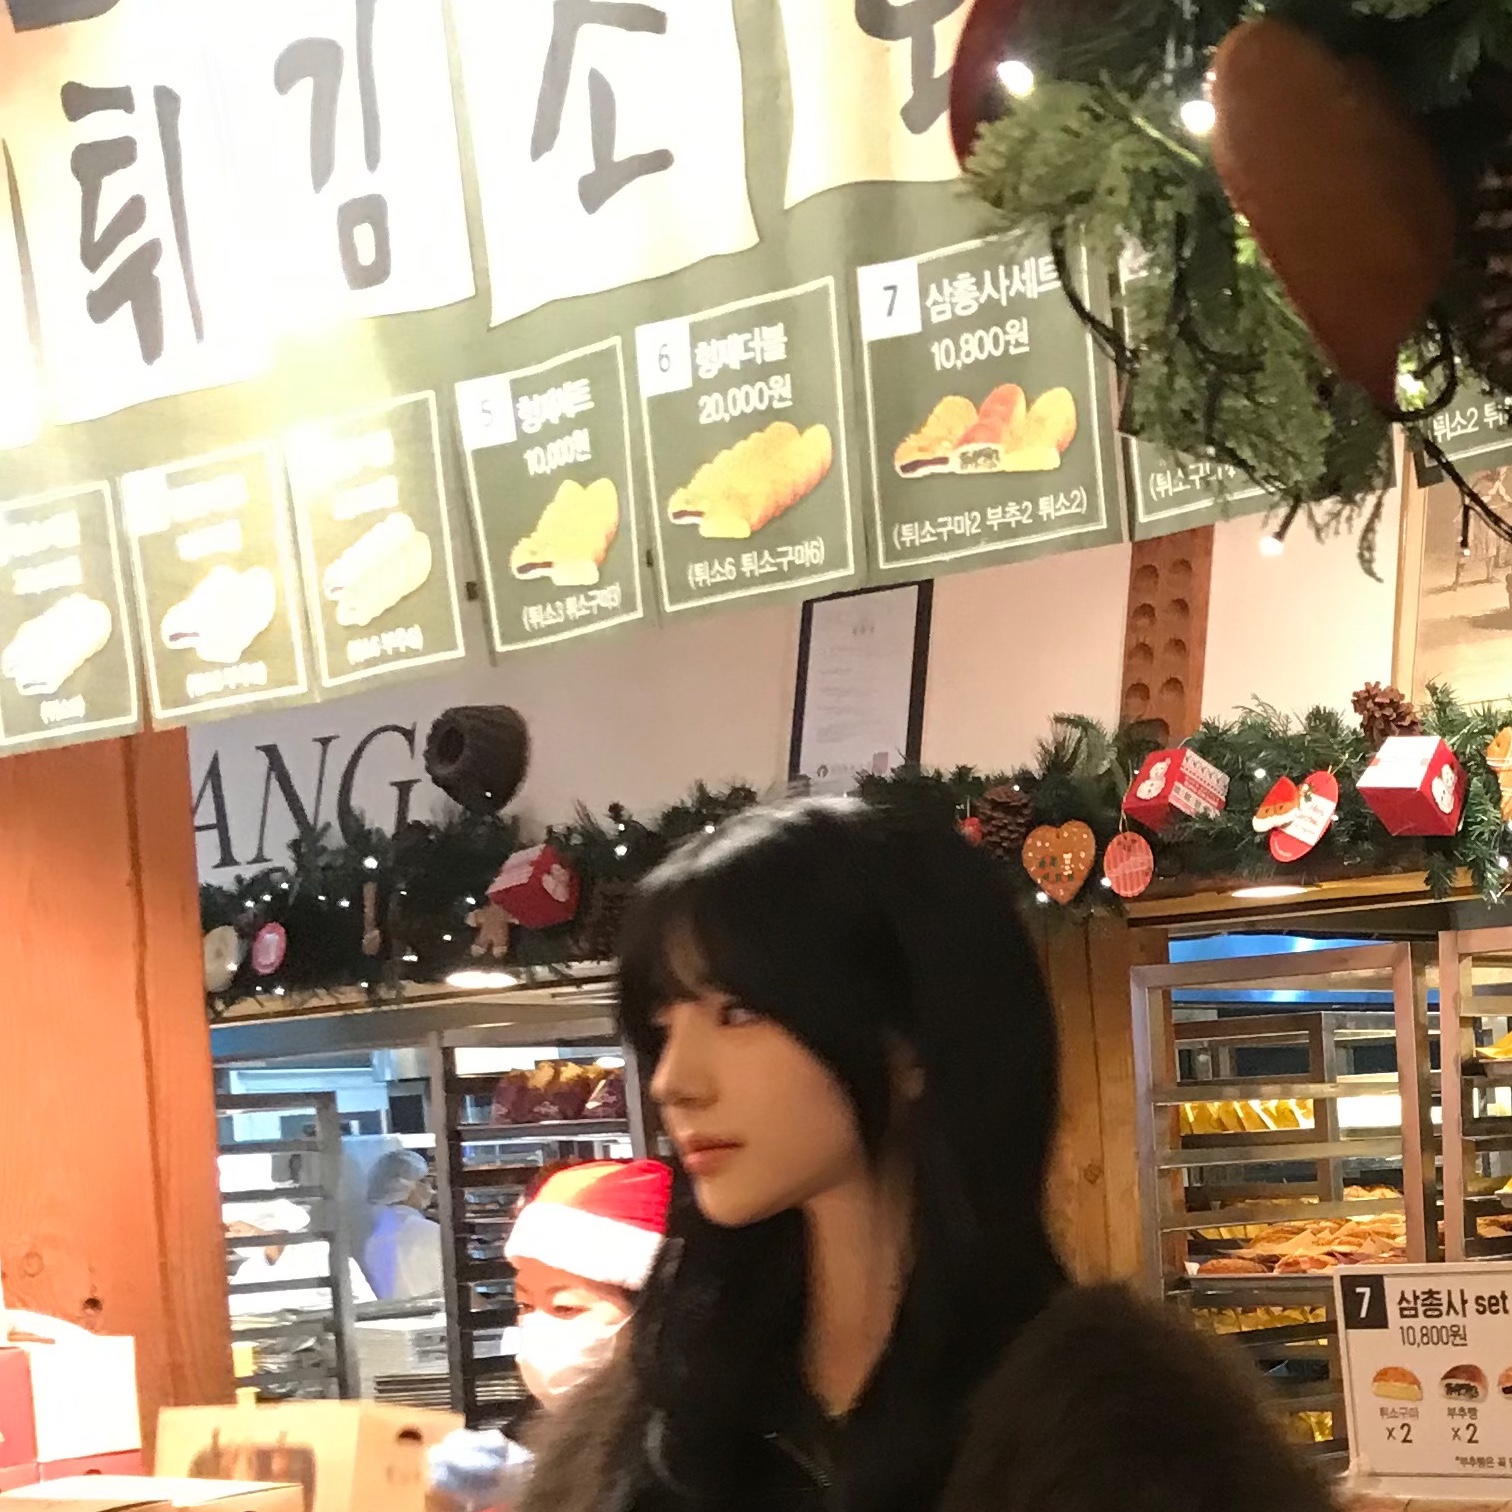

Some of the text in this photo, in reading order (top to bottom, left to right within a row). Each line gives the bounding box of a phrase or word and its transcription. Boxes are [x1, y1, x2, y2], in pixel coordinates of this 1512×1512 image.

[881, 284, 899, 317] 7
[925, 255, 1062, 323] 삼총사세트
[657, 343, 671, 373] 6
[930, 316, 1030, 371] 10,800원
[698, 373, 793, 425] 20,000원
[892, 486, 1088, 550] (튀소구마2 부추2 튀소2)
[687, 557, 737, 590] (튀소6
[1355, 1287, 1371, 1319] 7
[1397, 1288, 1510, 1319] 삼총사 set
[1399, 1324, 1469, 1348] 10,800원
